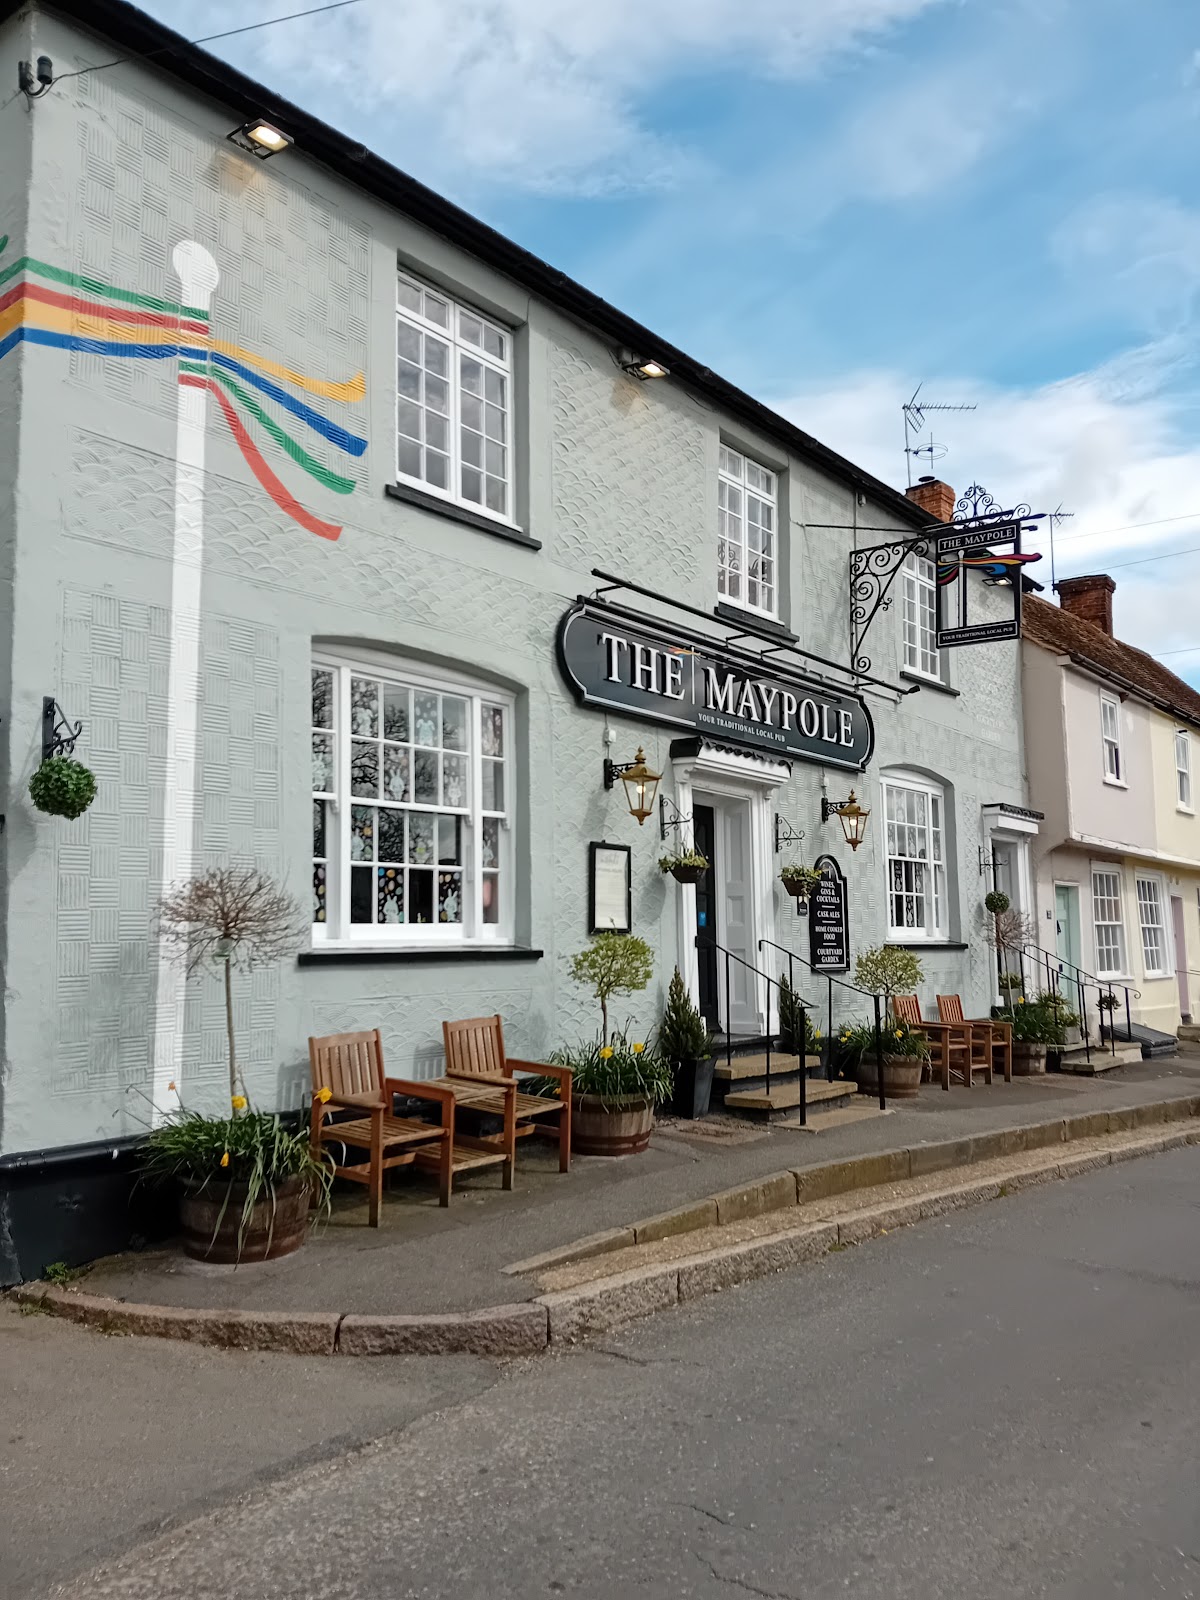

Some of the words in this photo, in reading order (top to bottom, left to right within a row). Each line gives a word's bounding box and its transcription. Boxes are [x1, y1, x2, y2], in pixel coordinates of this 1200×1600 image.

[942, 538, 961, 549] THE
[965, 529, 1012, 545] MAYPOLE
[956, 630, 986, 639] TRADITIONAL
[602, 632, 686, 700] THE
[706, 666, 854, 747] MAYPOLE
[698, 713, 715, 724] YOUR
[717, 718, 755, 735] TRADITIONAL
[756, 728, 774, 740] LOCAL
[774, 733, 786, 742] PUB
[816, 895, 840, 904] COCKTAILS
[824, 932, 836, 940] FOOD
